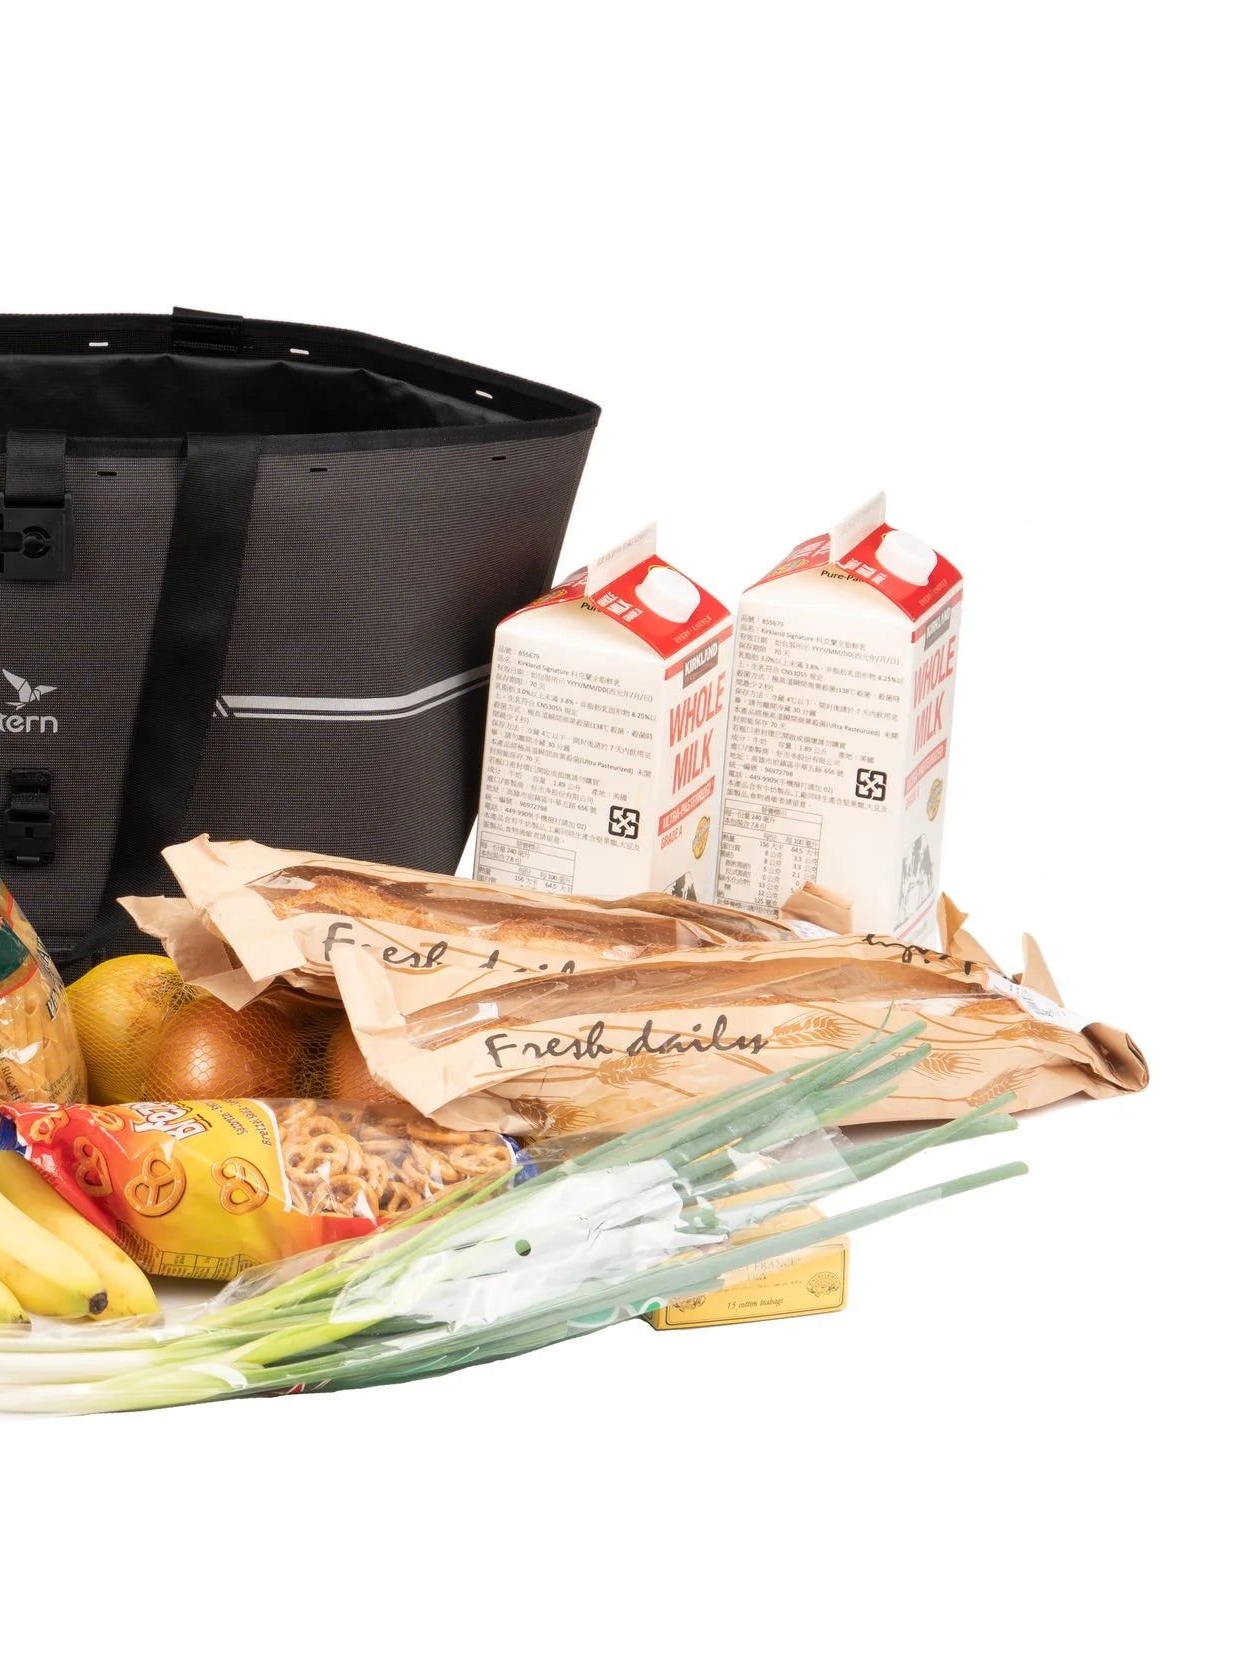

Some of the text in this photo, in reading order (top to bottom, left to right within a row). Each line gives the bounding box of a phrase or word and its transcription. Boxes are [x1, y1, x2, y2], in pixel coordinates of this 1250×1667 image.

[684, 645, 718, 673] KIRKLAND
[914, 636, 956, 708] WHOLE
[670, 671, 726, 747] WHOLE
[914, 691, 944, 754] MILK
[672, 728, 714, 795] MILK
[484, 1014, 769, 1068] Fresh daily
[727, 1298, 784, 1310] 15 cotton teabags
